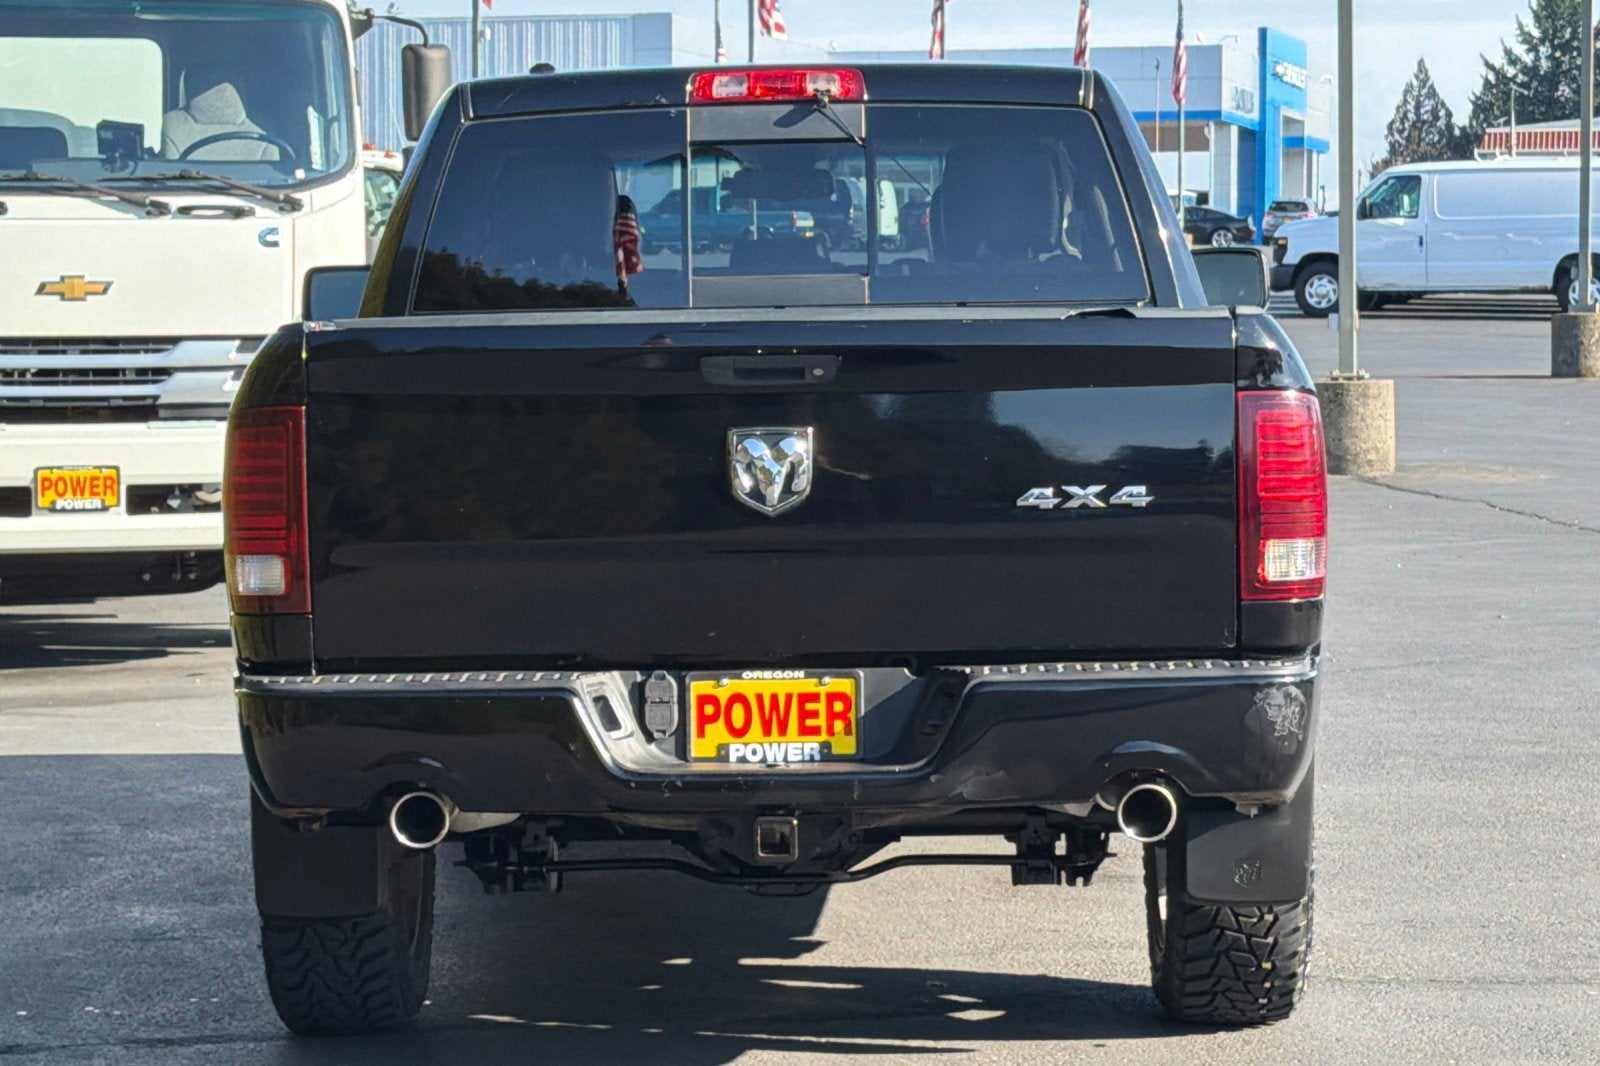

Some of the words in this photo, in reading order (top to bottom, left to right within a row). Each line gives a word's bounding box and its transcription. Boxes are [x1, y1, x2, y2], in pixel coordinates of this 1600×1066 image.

[41, 475, 116, 498] POWER
[1016, 484, 1155, 509] 4X4
[55, 499, 102, 510] POWER
[741, 670, 805, 680] OREGON
[695, 691, 853, 739] POWER
[728, 742, 821, 763] POWER
